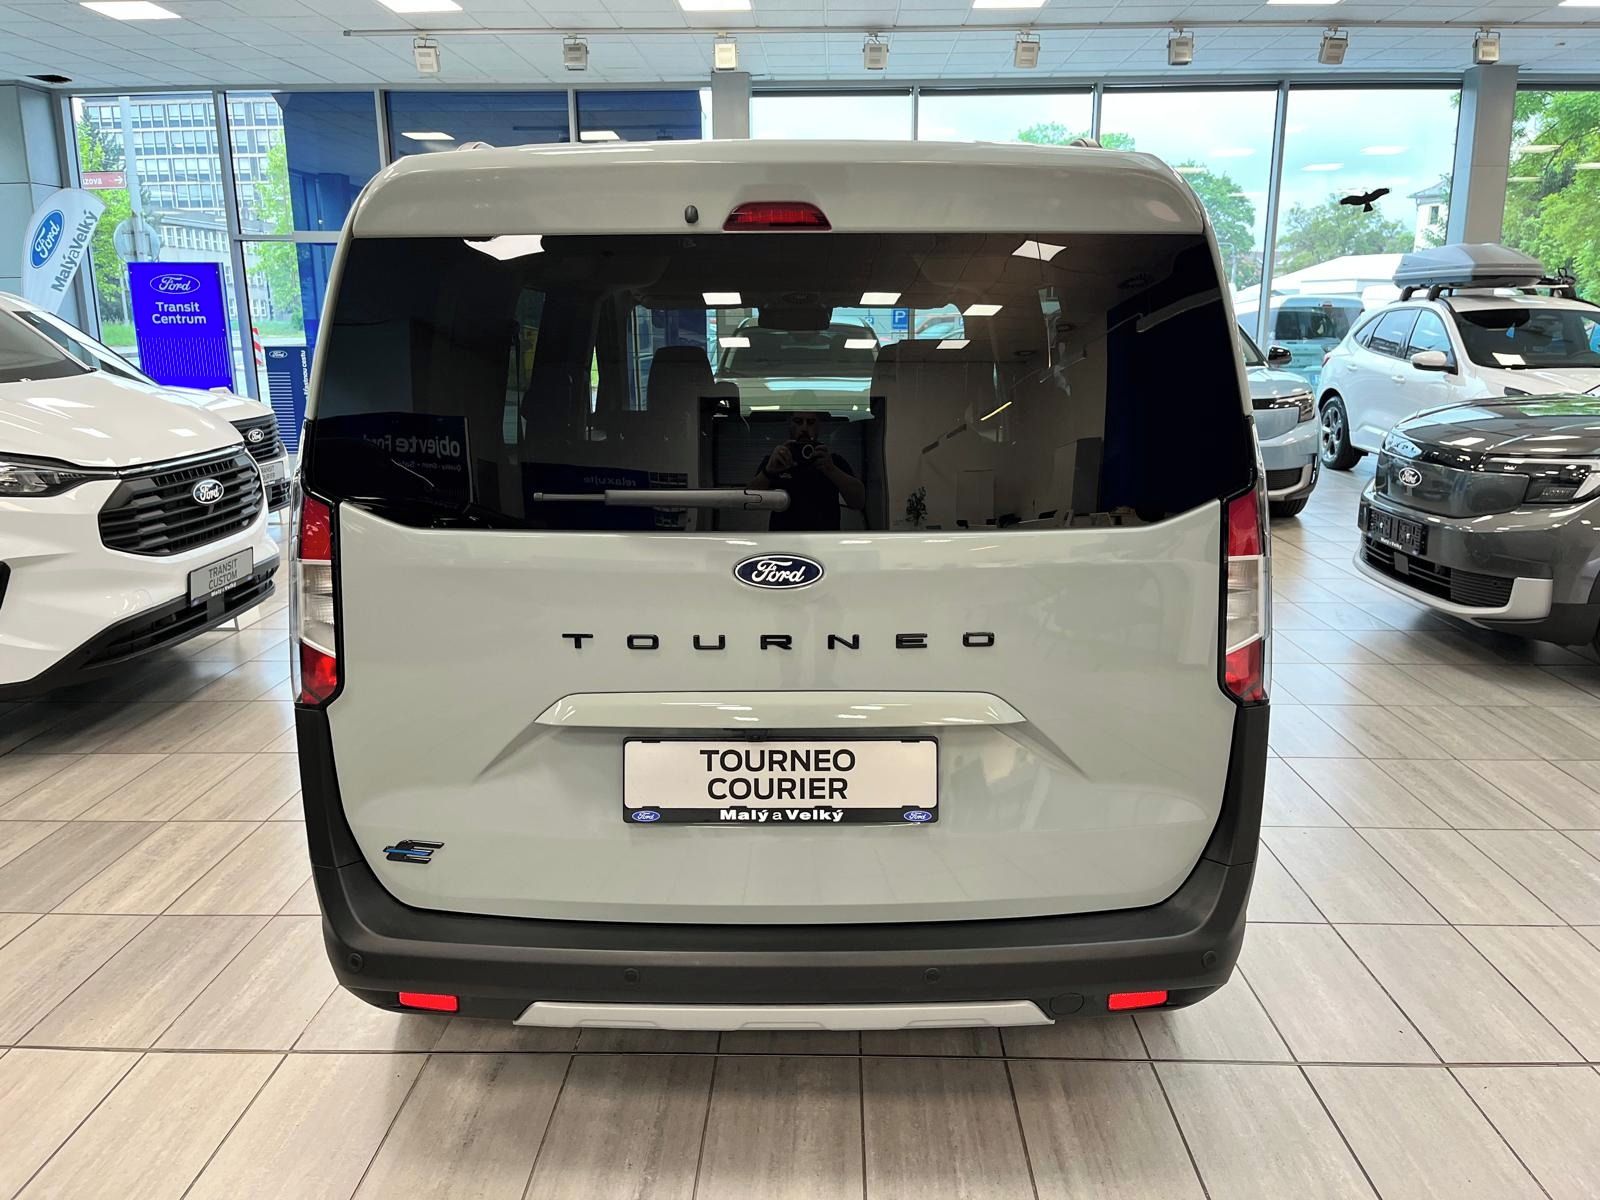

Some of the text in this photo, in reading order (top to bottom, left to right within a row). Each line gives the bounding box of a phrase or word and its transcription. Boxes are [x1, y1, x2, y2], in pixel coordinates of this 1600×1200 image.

[154, 301, 201, 313] Transit
[151, 313, 207, 325] Centrum
[208, 558, 238, 579] TRANSIT
[751, 560, 807, 582] Ford
[208, 569, 238, 590] CUSTOM
[561, 632, 996, 651] TOURNEO
[699, 748, 857, 773] TOURNEO
[707, 777, 849, 800] COURIER
[719, 809, 769, 822] Malý
[772, 812, 783, 820] a
[787, 809, 845, 822] Velký
